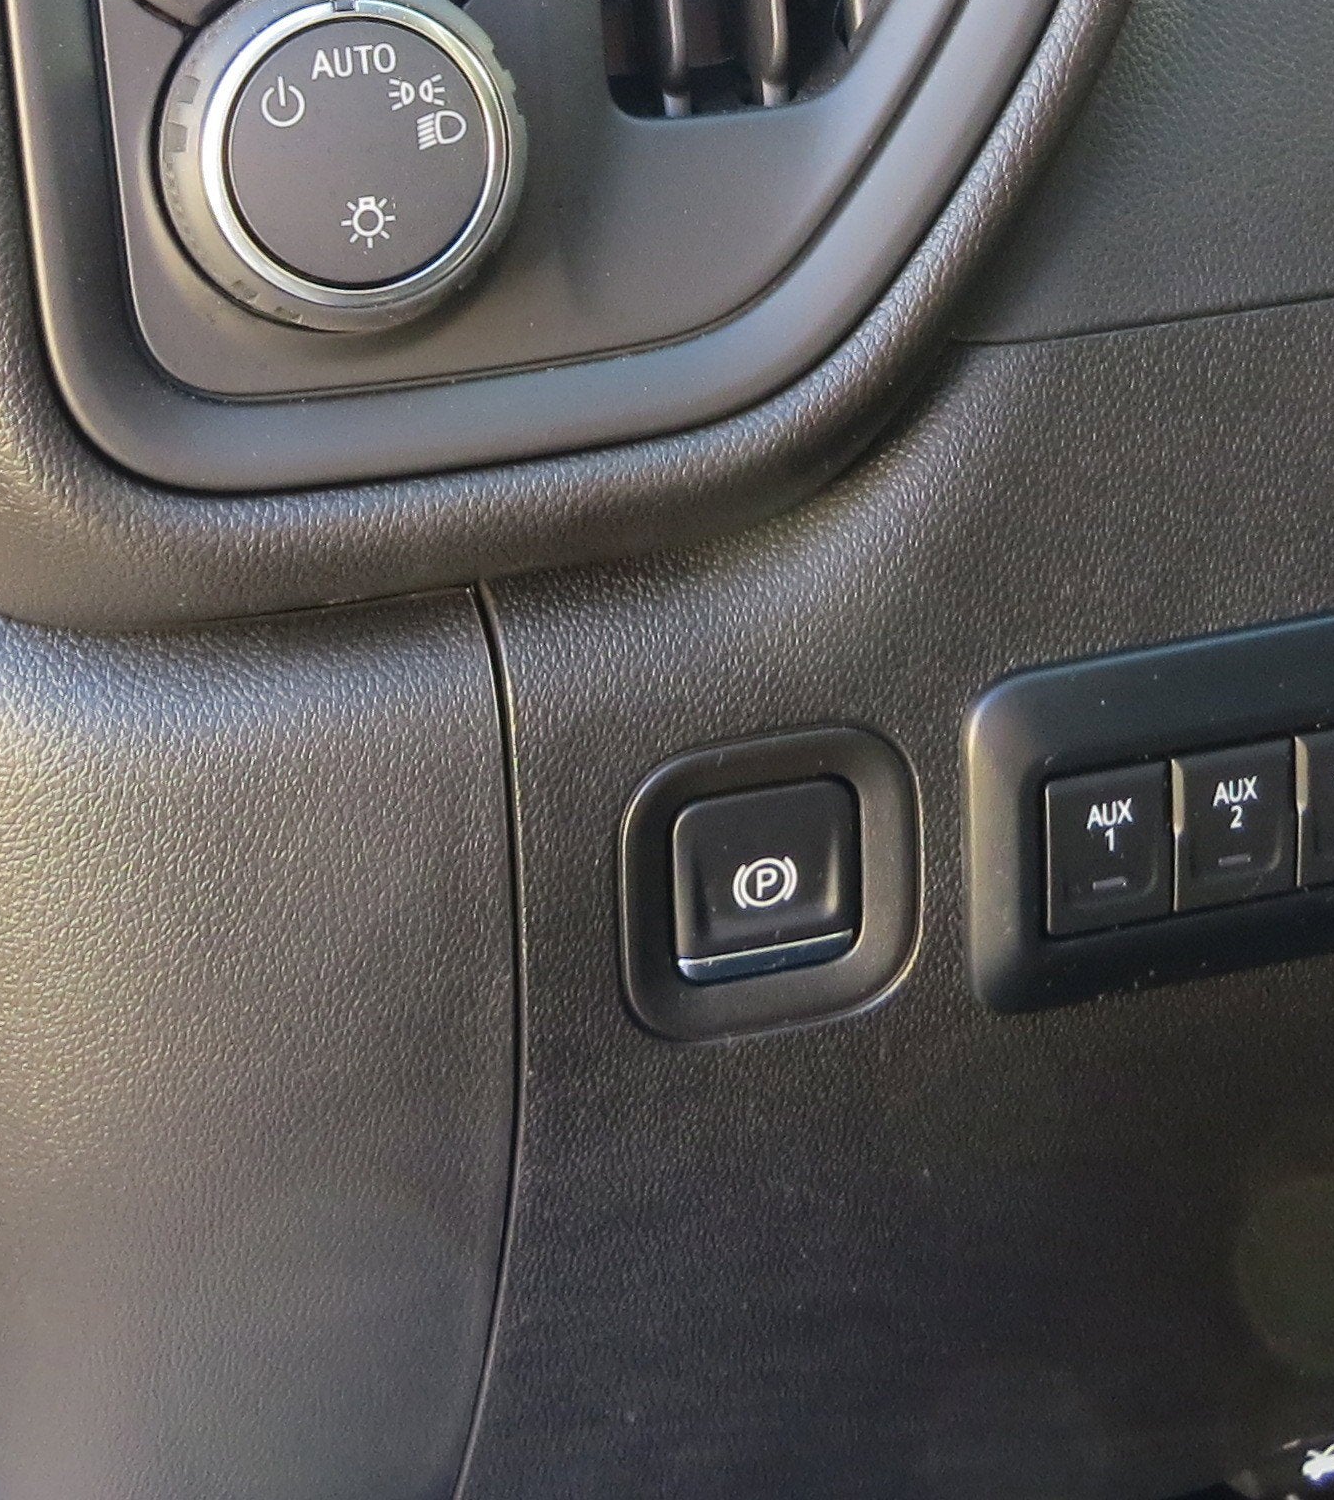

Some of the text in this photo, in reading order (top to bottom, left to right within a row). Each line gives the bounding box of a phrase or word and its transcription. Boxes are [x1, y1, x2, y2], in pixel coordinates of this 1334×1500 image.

[311, 43, 397, 80] AUTO
[1213, 775, 1258, 807] AUX
[1086, 797, 1133, 830] AUX
[1230, 804, 1243, 829] 2
[1104, 827, 1115, 852] 1
